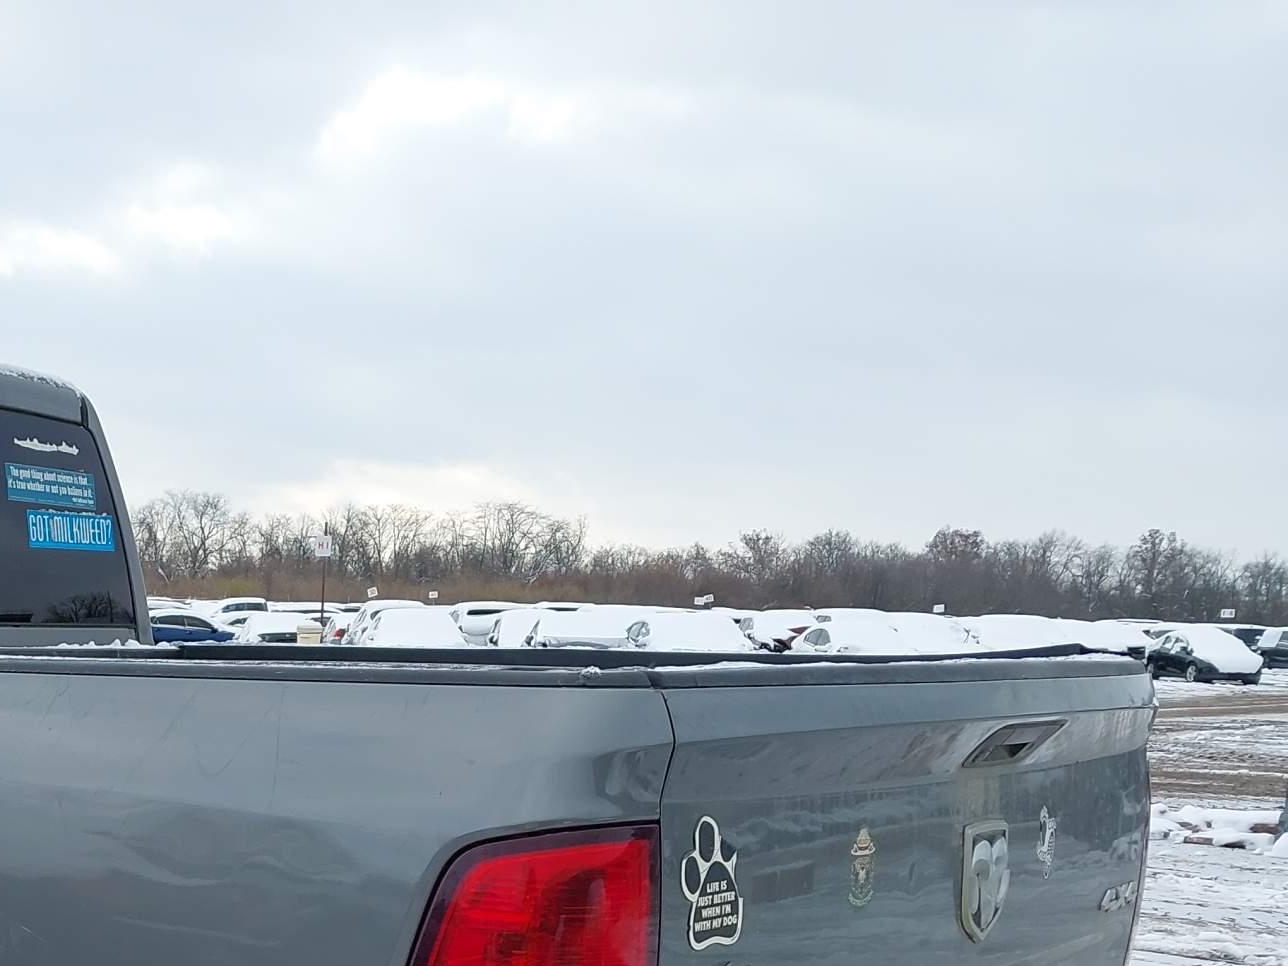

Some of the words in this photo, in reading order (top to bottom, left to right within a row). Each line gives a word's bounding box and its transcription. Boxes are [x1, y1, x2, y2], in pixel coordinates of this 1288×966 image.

[31, 469, 43, 481] thing
[44, 470, 56, 481] about
[57, 473, 73, 483] science
[27, 481, 44, 491] whether
[59, 487, 67, 496] you
[29, 515, 49, 542] GOT
[53, 516, 112, 545] MILKWEED?
[707, 881, 719, 893] LIFE
[721, 880, 727, 890] IS
[698, 895, 712, 907] JUST
[713, 891, 735, 904] BETTER
[702, 905, 721, 919] WHEN
[722, 904, 731, 915] I'M
[695, 920, 711, 932] WITH
[712, 917, 722, 929] MY
[723, 914, 737, 927] DOG
